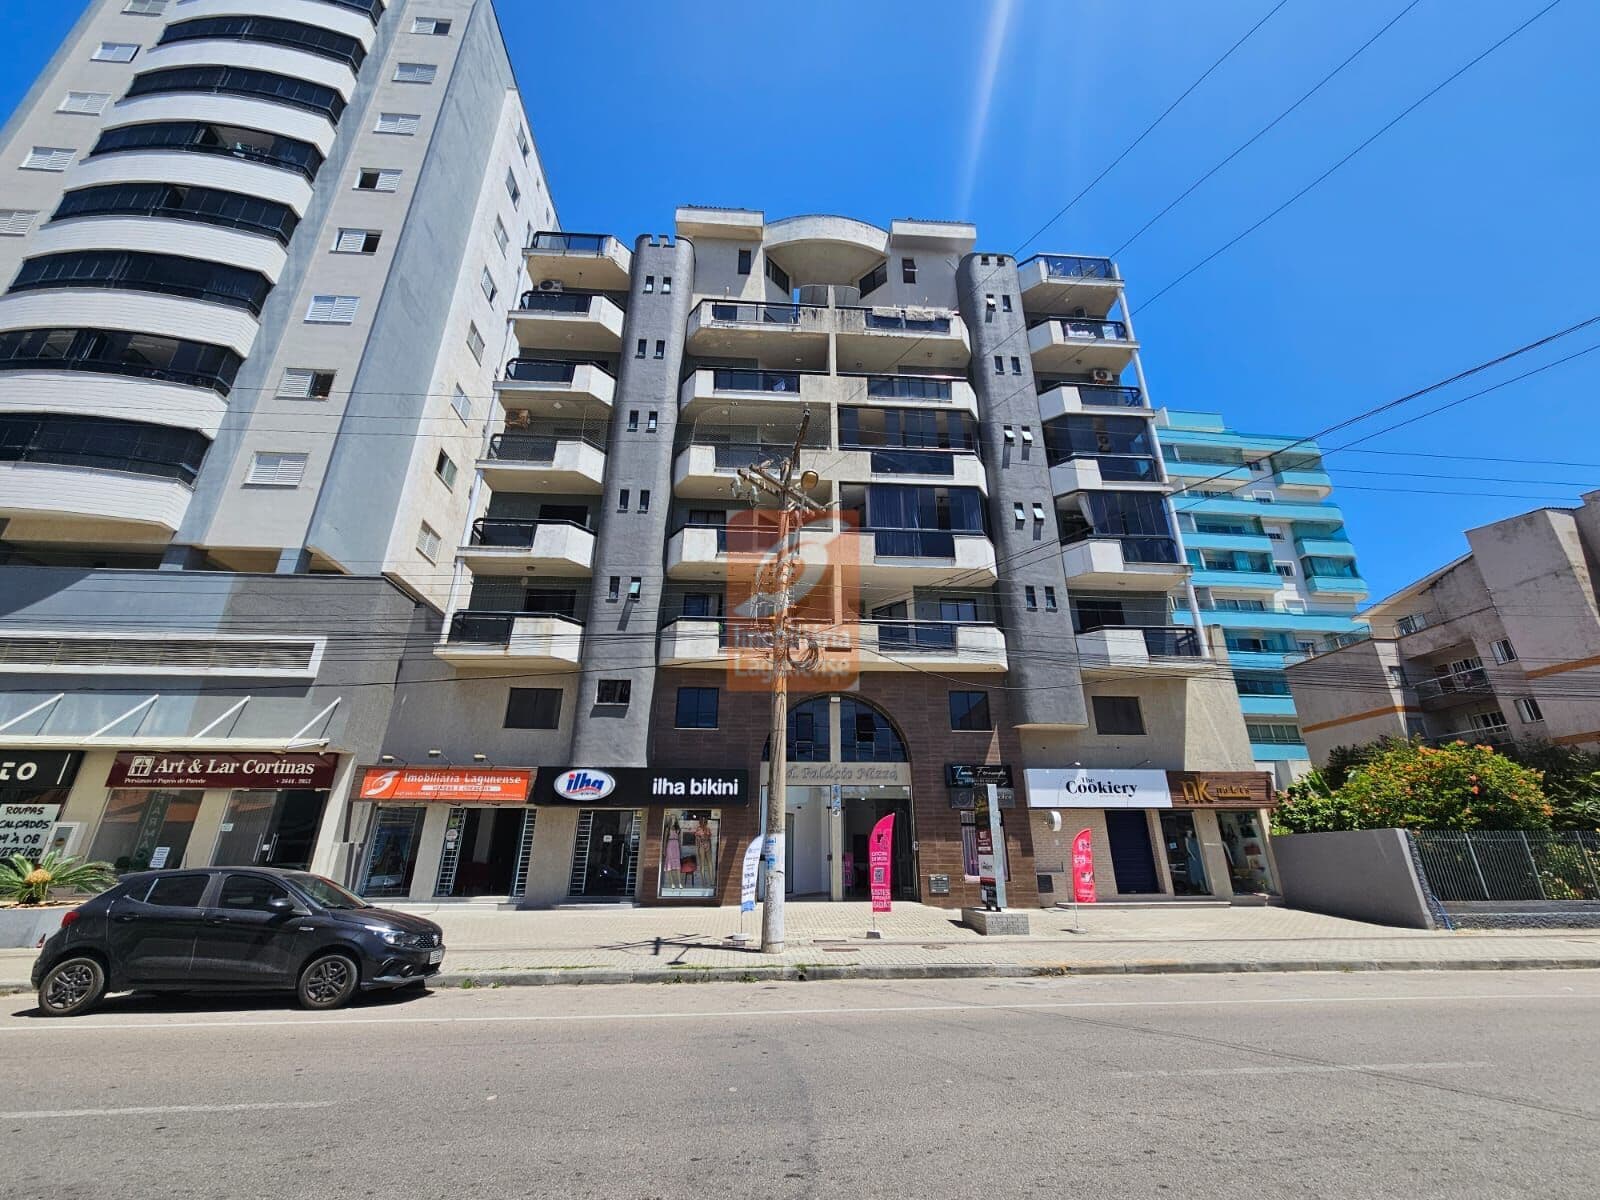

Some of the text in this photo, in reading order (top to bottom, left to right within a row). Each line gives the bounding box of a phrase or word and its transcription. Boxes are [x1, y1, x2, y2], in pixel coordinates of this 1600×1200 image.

[154, 758, 315, 775] Art & Lar Cortinas
[464, 773, 521, 786] Lagunense
[567, 772, 605, 792] ilha
[652, 778, 739, 796] ilha bikini
[1065, 780, 1138, 798] Cookiery
[6, 806, 45, 816] ROUPAS
[0, 820, 51, 830] CALÇADOS
[23, 833, 41, 844] 08
